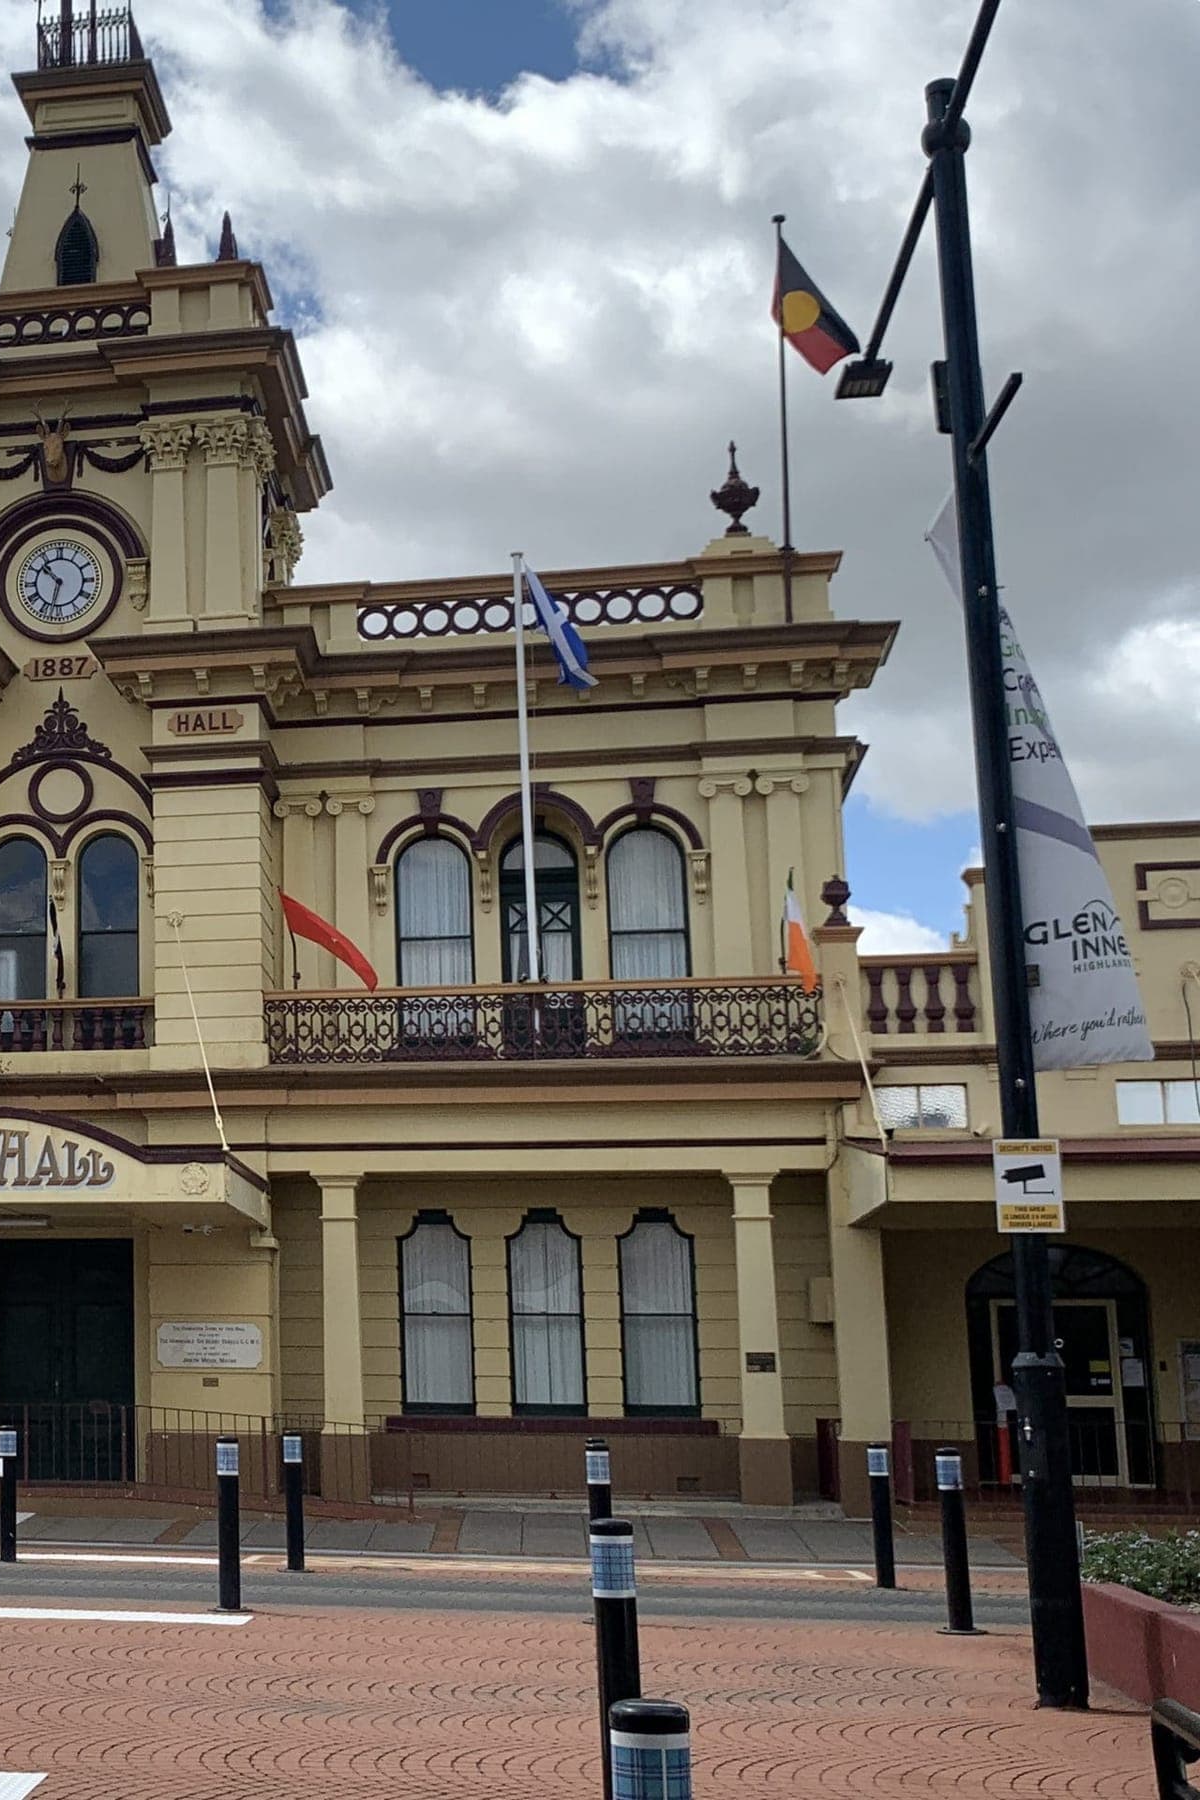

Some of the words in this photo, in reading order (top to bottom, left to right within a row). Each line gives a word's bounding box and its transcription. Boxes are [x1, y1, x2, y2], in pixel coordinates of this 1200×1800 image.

[33, 656, 89, 678] 1887
[177, 711, 234, 733] HALL
[1024, 911, 1108, 945] GLEN
[1072, 935, 1131, 962] INNE
